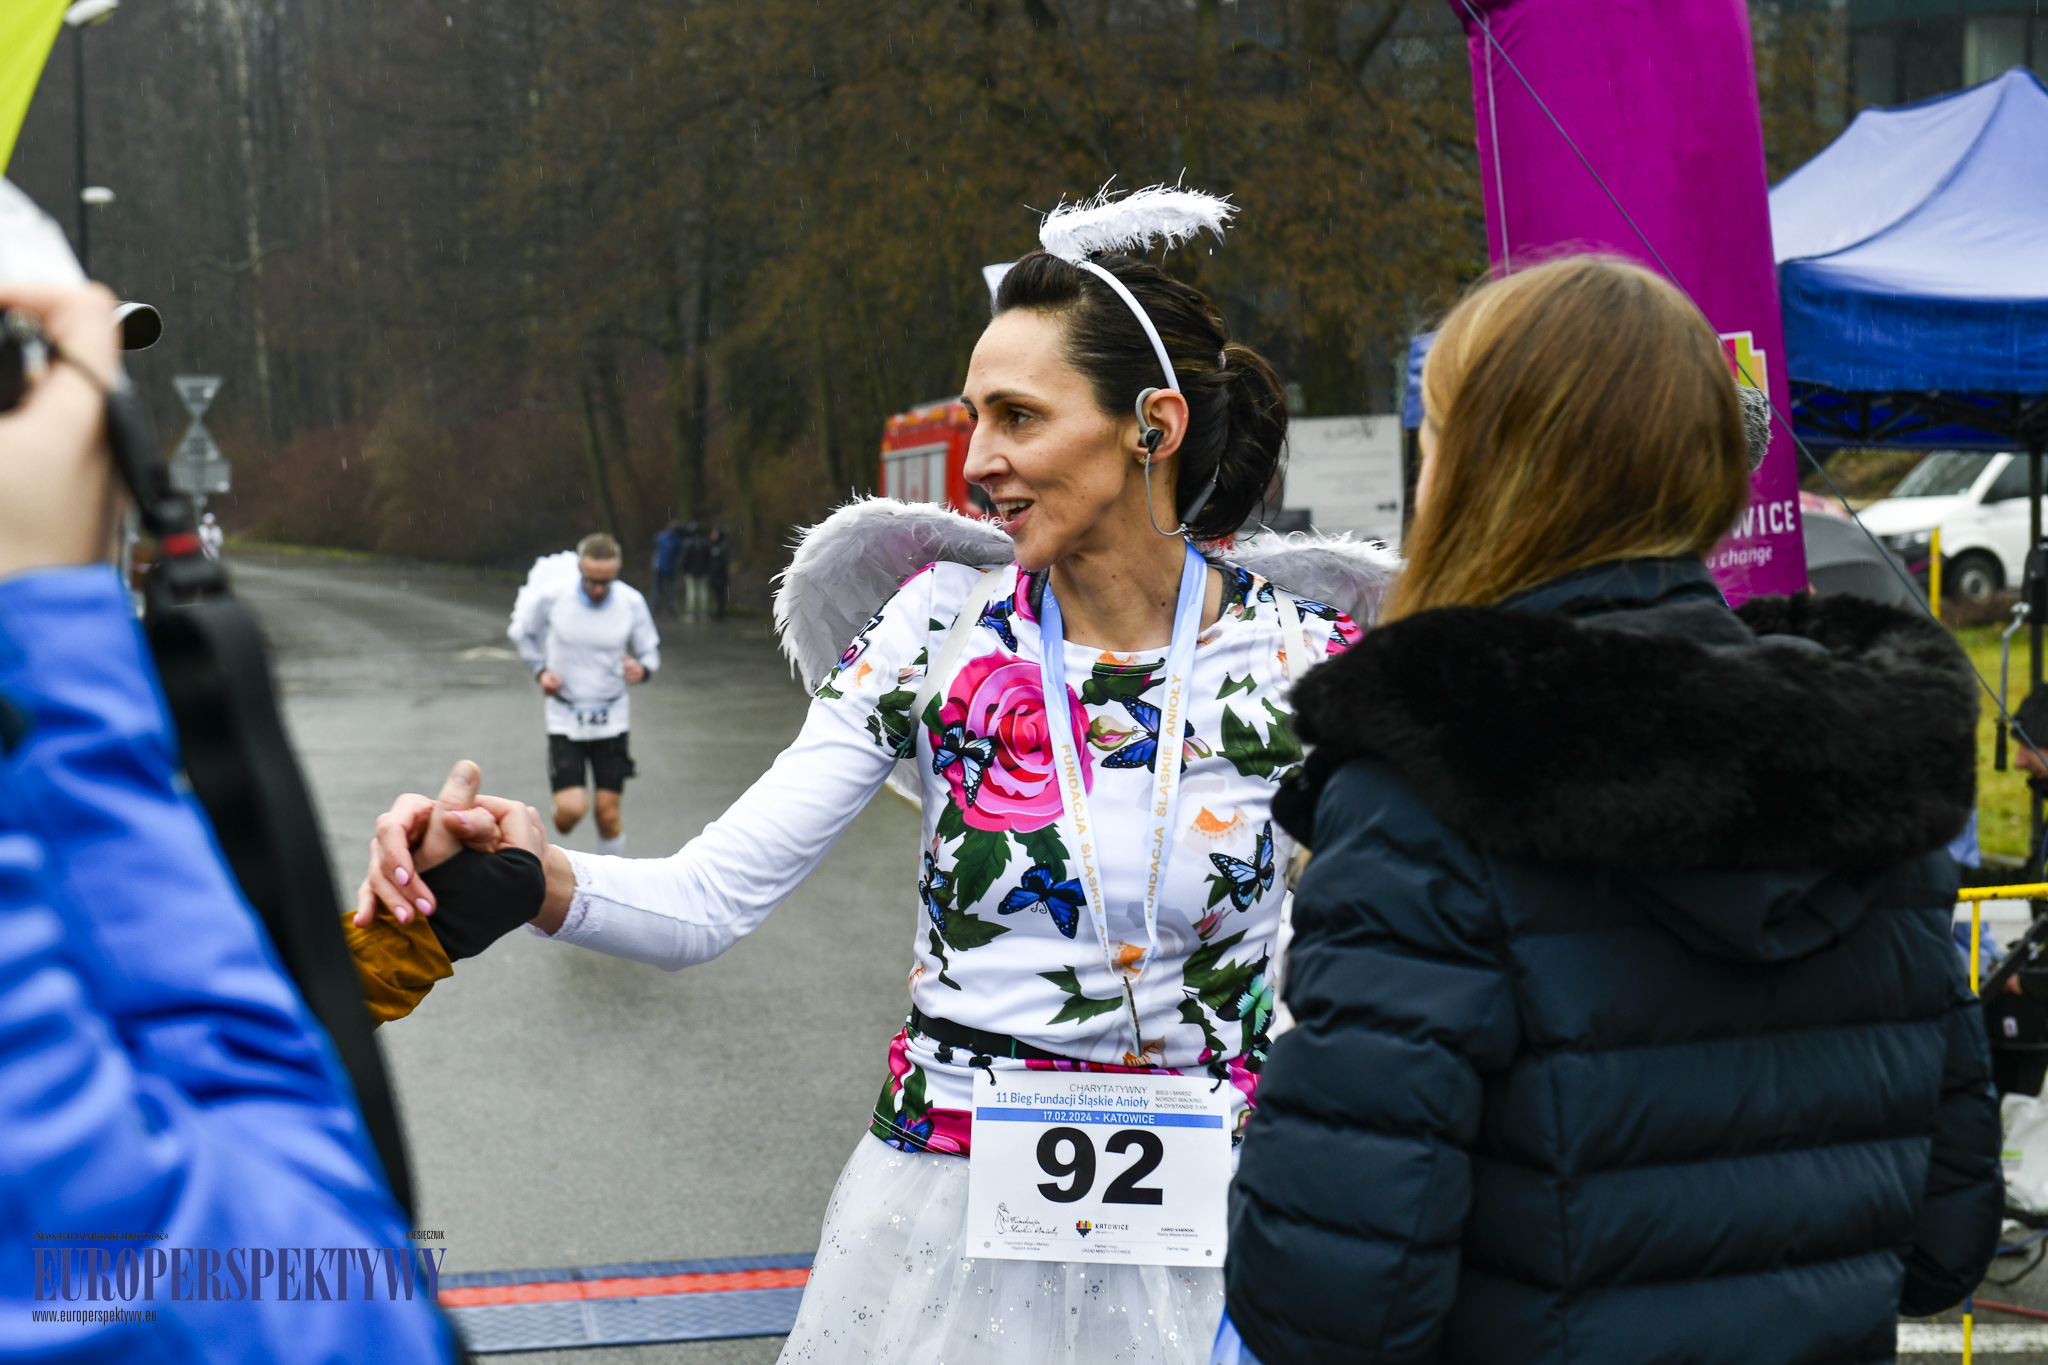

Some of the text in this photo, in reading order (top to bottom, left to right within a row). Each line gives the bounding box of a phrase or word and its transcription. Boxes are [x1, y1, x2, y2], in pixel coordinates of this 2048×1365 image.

[1731, 500, 1795, 540] WICE
[1720, 545, 1773, 567] change
[1147, 674, 1182, 919] FUNDACJA ŚLĄSKIE ANIOŁY
[1061, 744, 1087, 835] FUNDACJA
[1081, 843, 1102, 915] ŚLĄSKIE
[1069, 1083, 1148, 1094] CHARYTATYWNY
[996, 1092, 1150, 1109] 11 Bieg Fundacji Śląskie Anioły
[1043, 1111, 1092, 1122] 17.02.2024
[1103, 1113, 1155, 1125] KATOWICE
[1036, 1126, 1164, 1206] 92
[1094, 1223, 1130, 1231] KATOWICE
